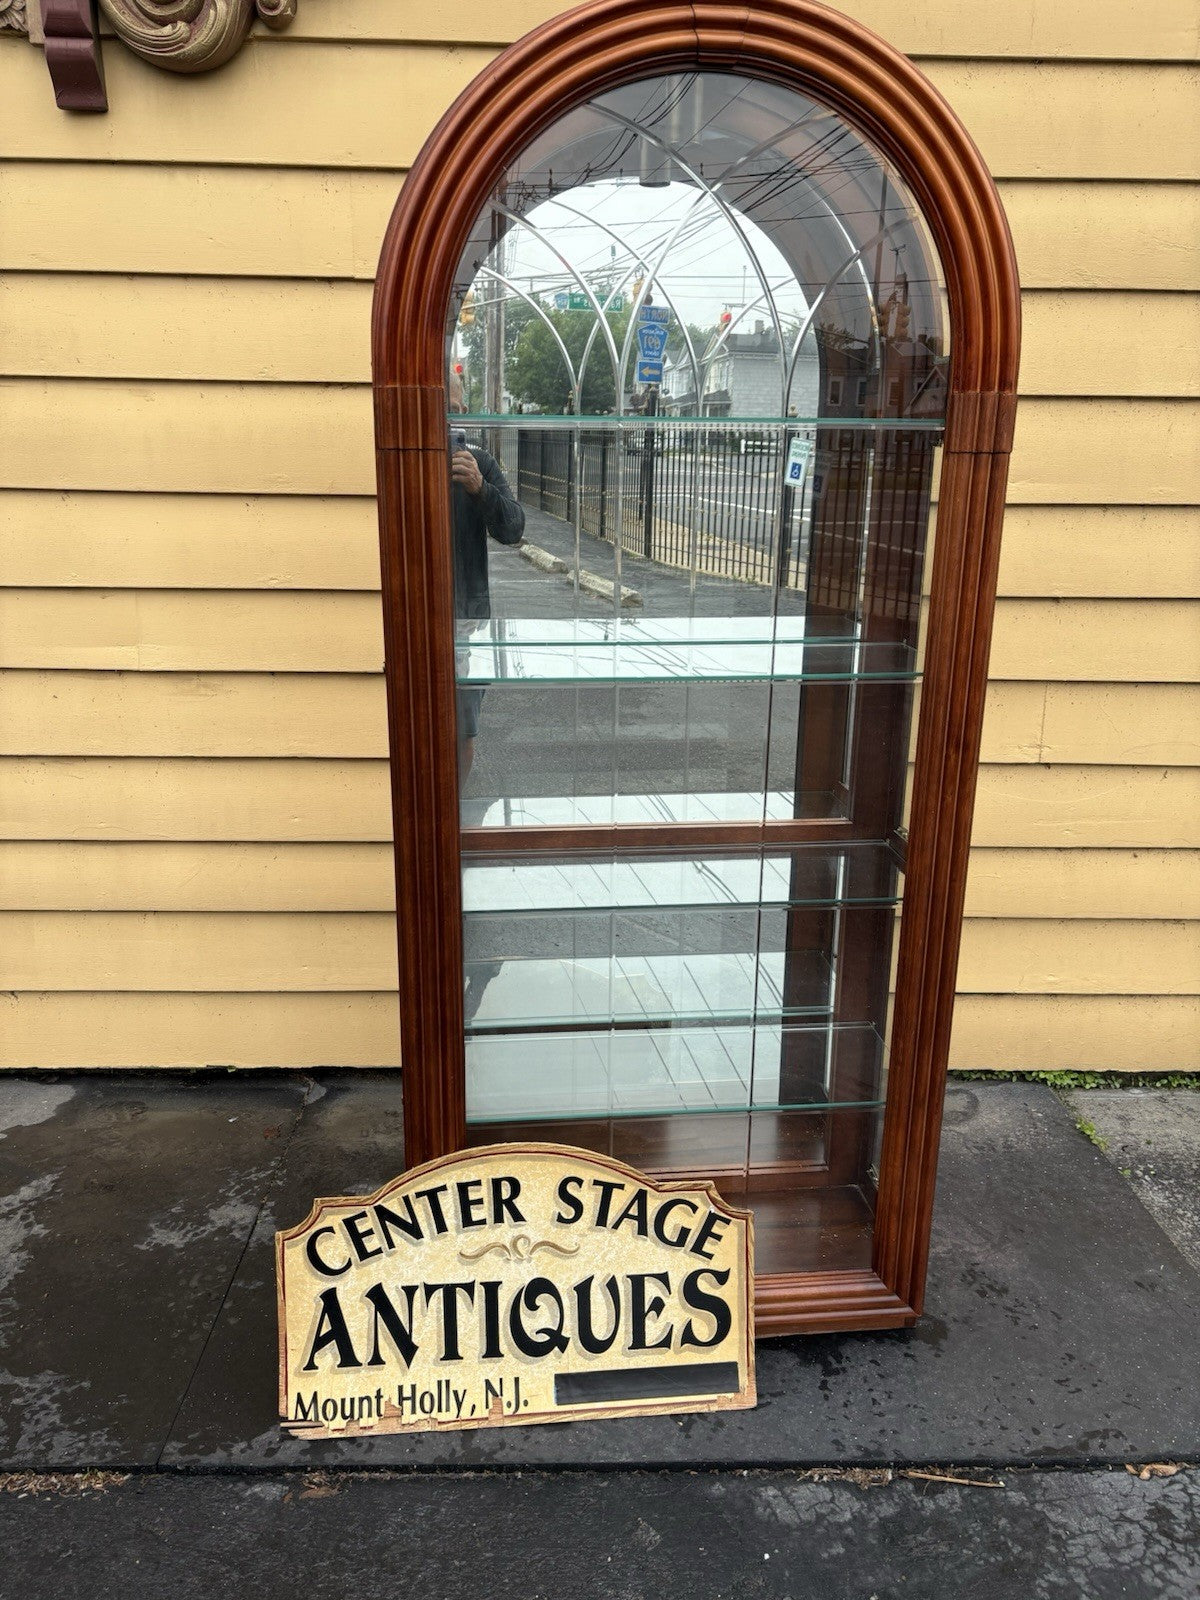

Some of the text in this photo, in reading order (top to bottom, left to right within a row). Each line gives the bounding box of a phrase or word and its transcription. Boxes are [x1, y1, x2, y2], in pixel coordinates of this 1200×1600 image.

[306, 1176, 732, 1277] CENTER STAGE
[302, 1268, 732, 1371] ANTIQUES
[293, 1376, 530, 1422] Mount Holly, N.J.
